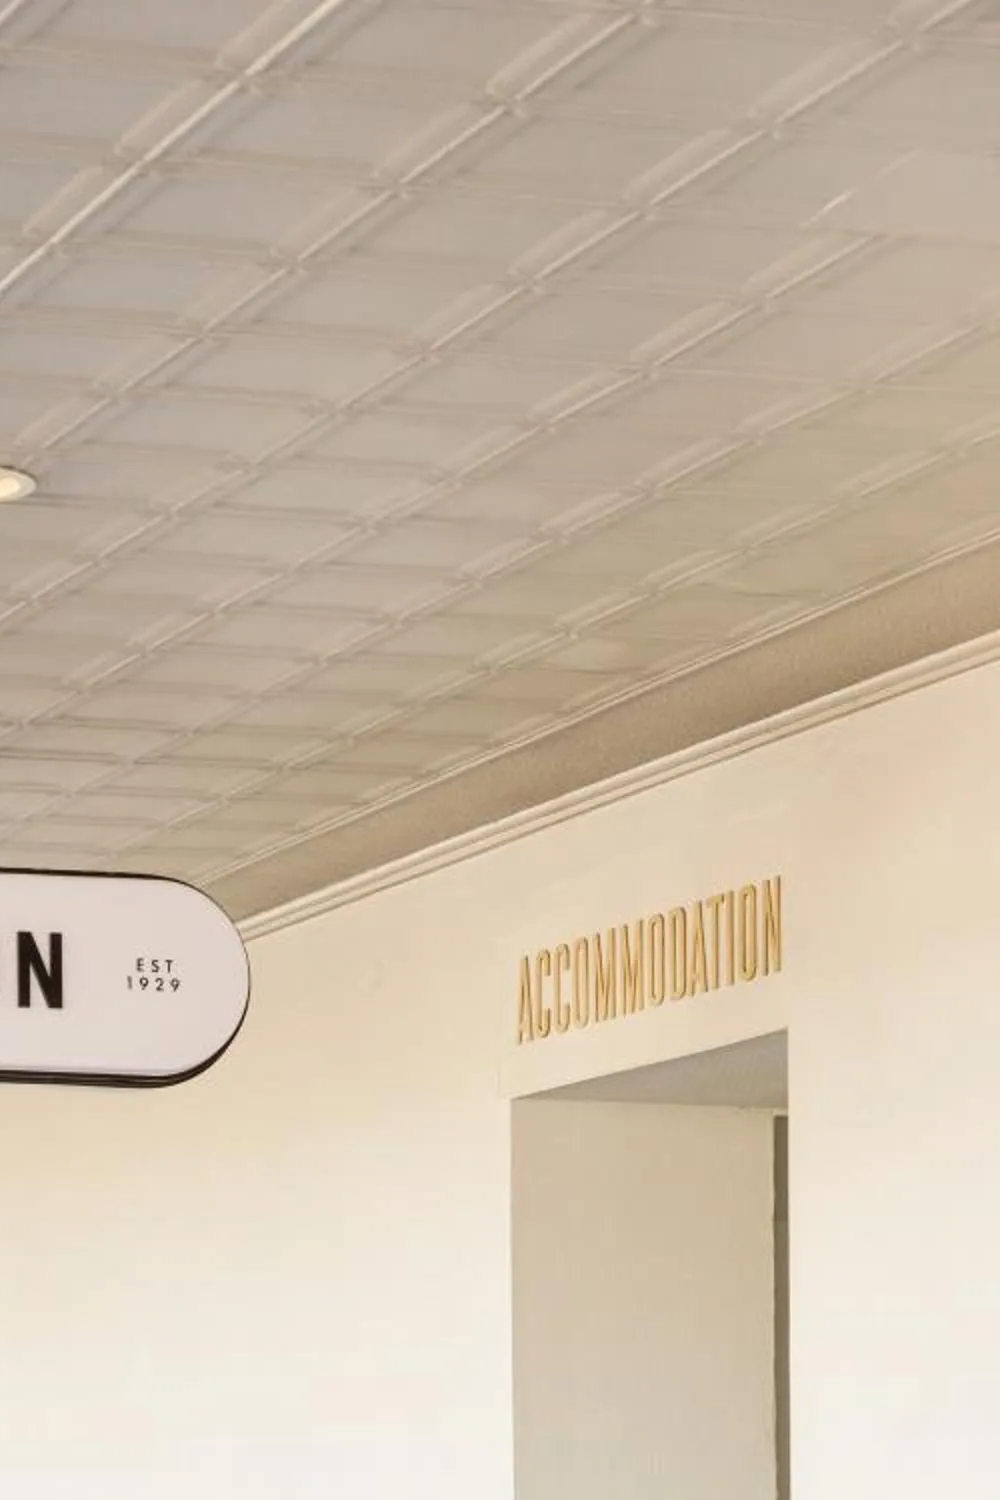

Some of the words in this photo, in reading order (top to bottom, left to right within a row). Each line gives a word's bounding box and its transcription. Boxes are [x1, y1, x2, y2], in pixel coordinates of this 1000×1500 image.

[135, 957, 176, 974] EST
[517, 874, 783, 1045] ACCOMMODATION
[126, 975, 182, 992] 1929
